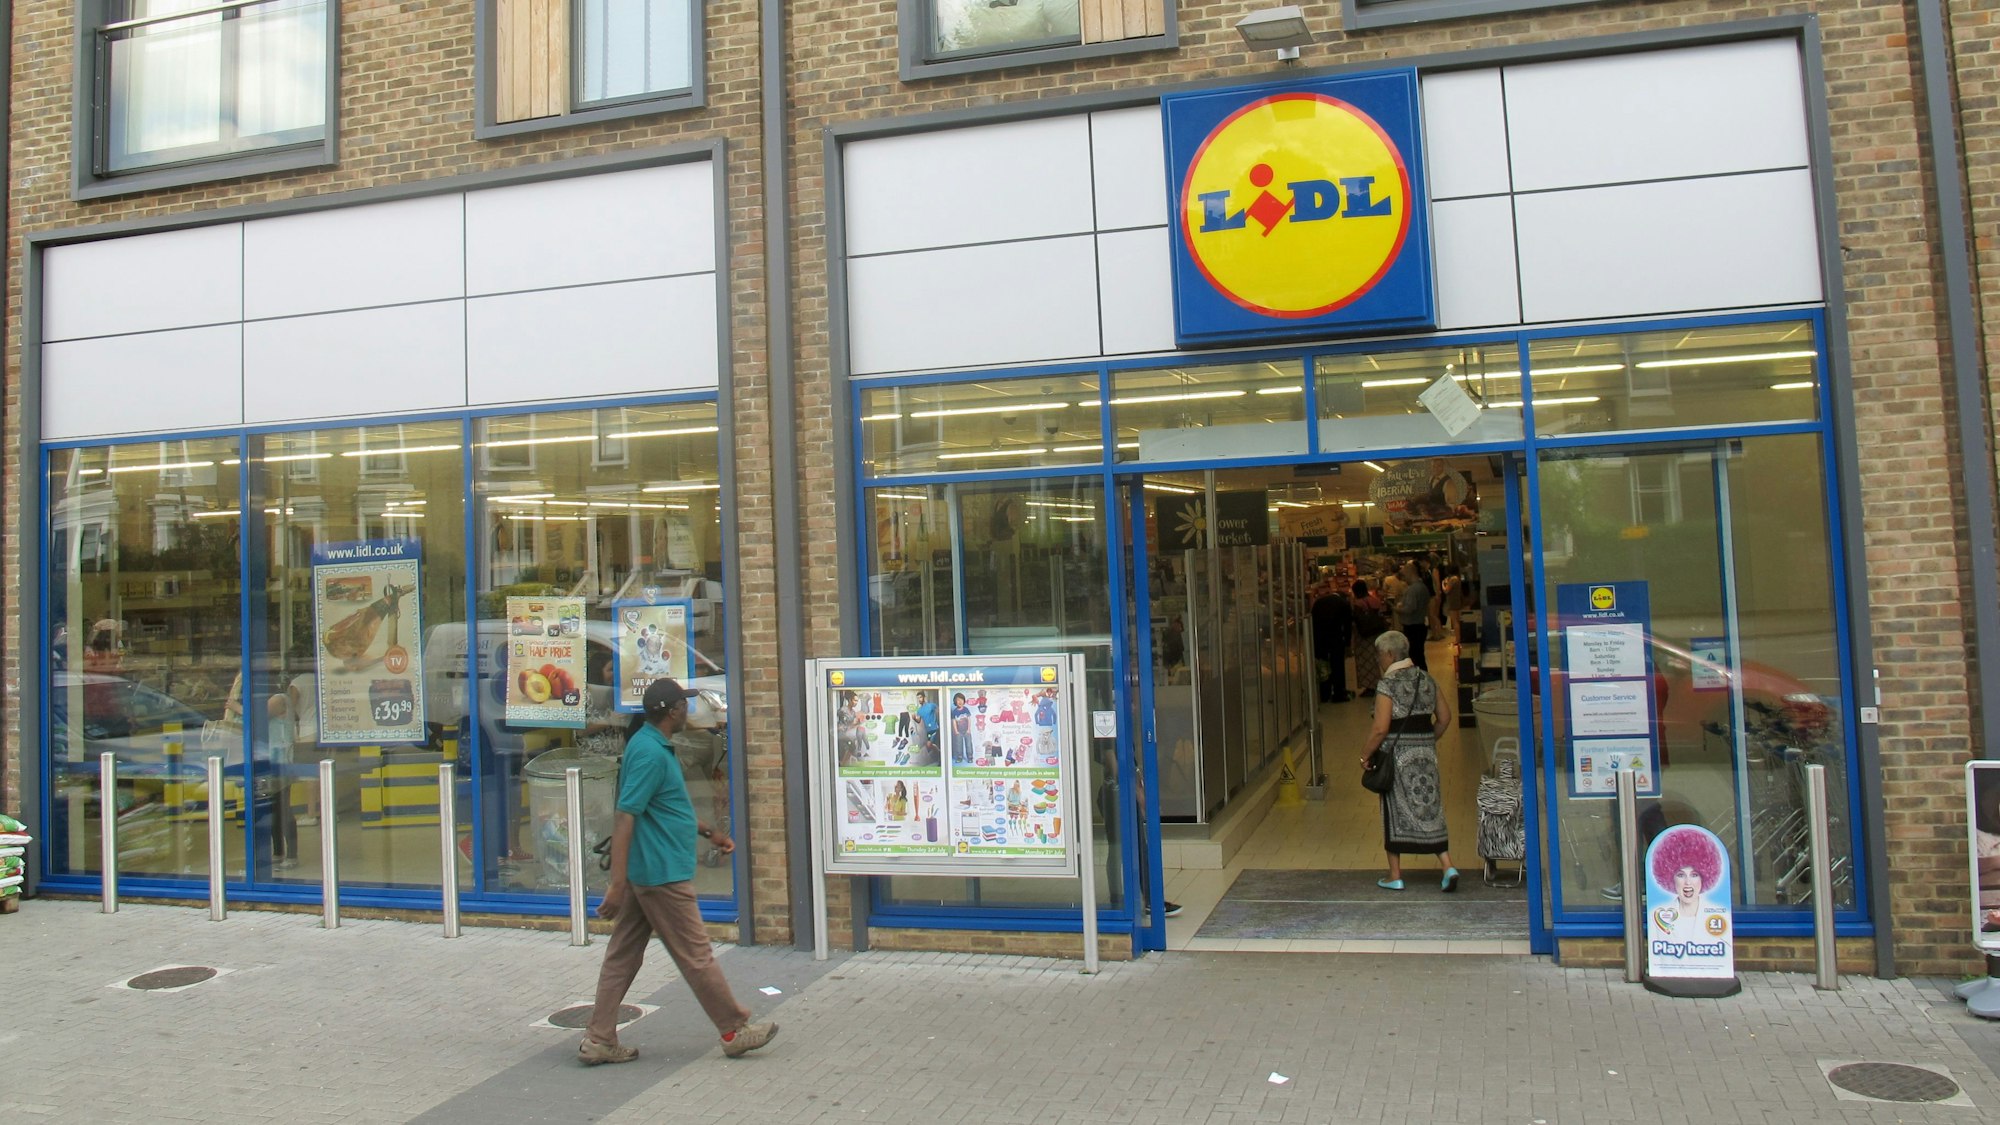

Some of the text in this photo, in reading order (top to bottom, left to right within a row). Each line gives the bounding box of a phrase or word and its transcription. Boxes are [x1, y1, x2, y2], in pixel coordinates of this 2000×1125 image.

[1300, 516, 1323, 530] Fresh
[327, 543, 404, 559] www.lidl.co.uk
[529, 646, 572, 658] HALF PRICE
[390, 657, 402, 666] TV
[632, 678, 644, 686] WE
[898, 670, 984, 683] www.lidl.co.uk
[1709, 918, 1722, 929] £1
[1653, 941, 1724, 958] Play here!
